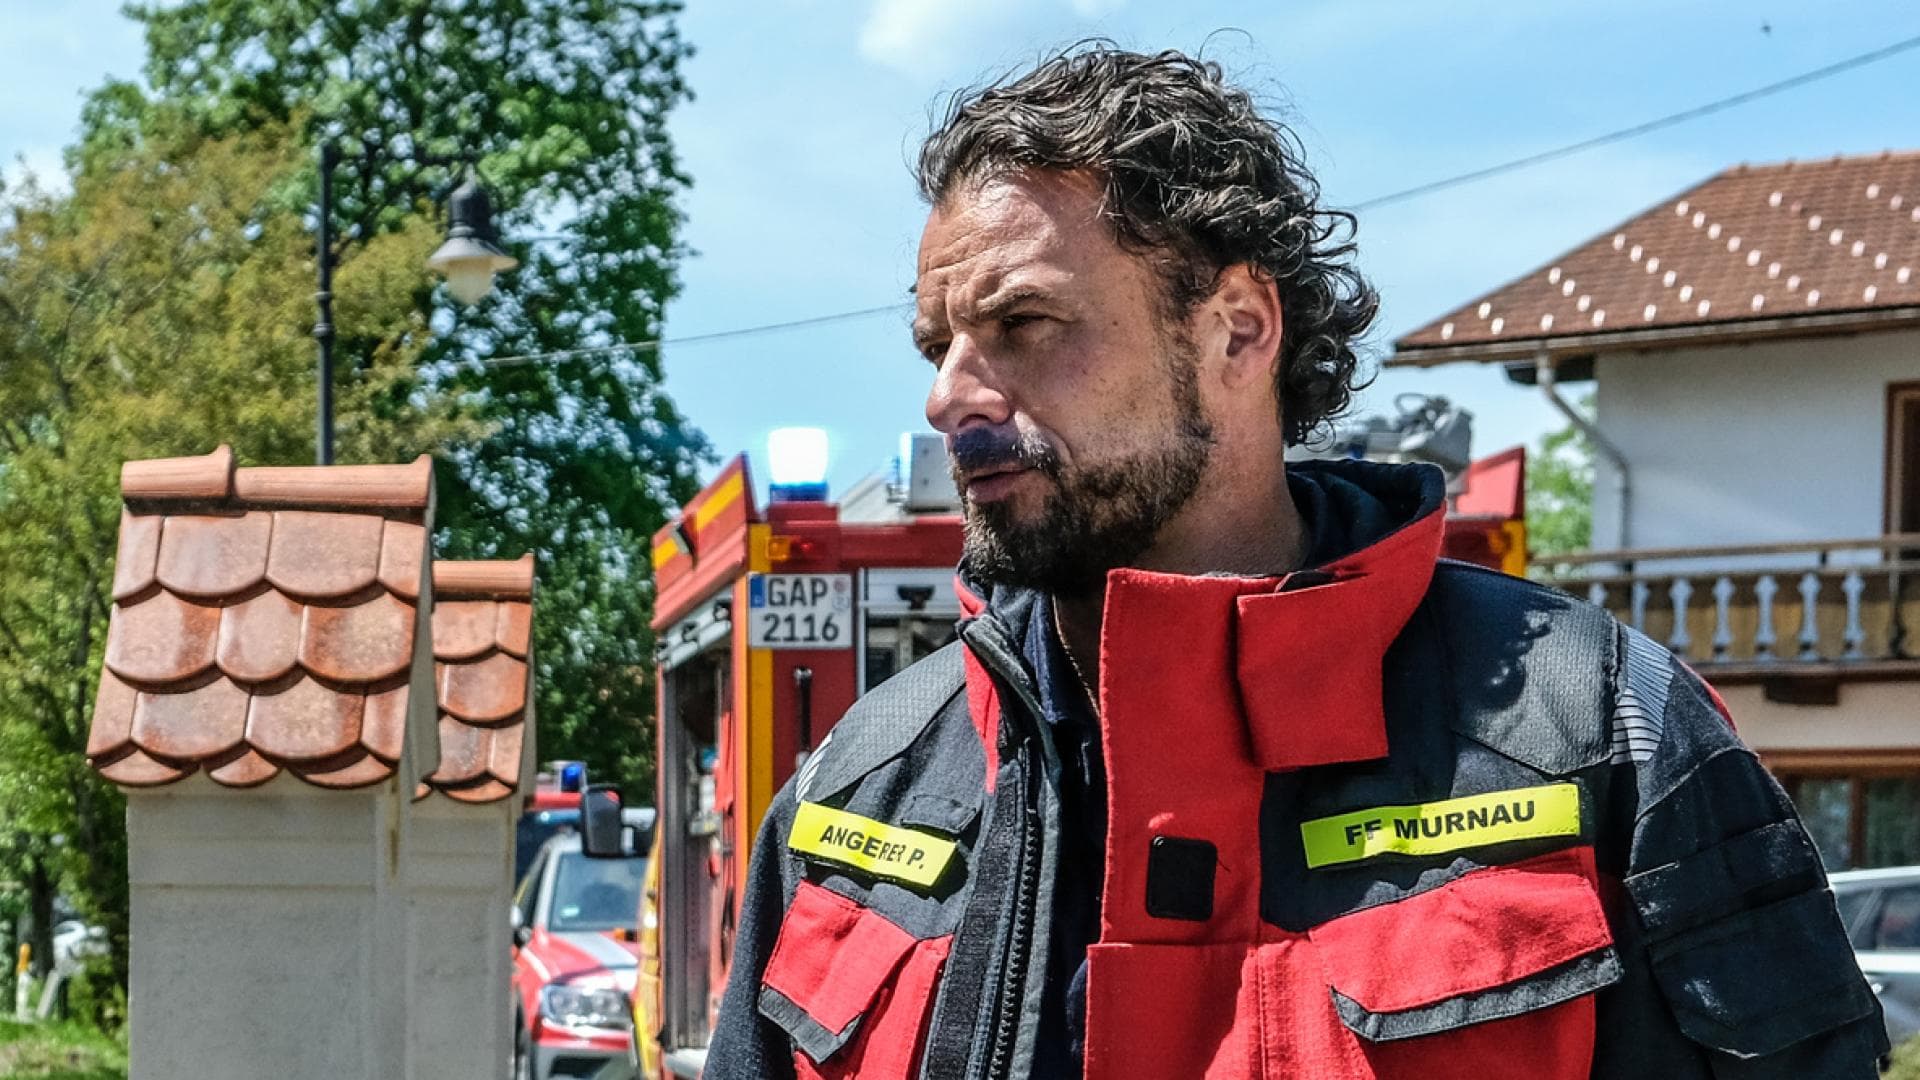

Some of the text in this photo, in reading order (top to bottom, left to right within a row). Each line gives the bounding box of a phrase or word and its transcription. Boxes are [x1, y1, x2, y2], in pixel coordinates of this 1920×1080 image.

[768, 577, 828, 607] GAP
[763, 612, 839, 642] 2116
[1344, 800, 1535, 846] FF MURNAU
[906, 848, 925, 869] P.
